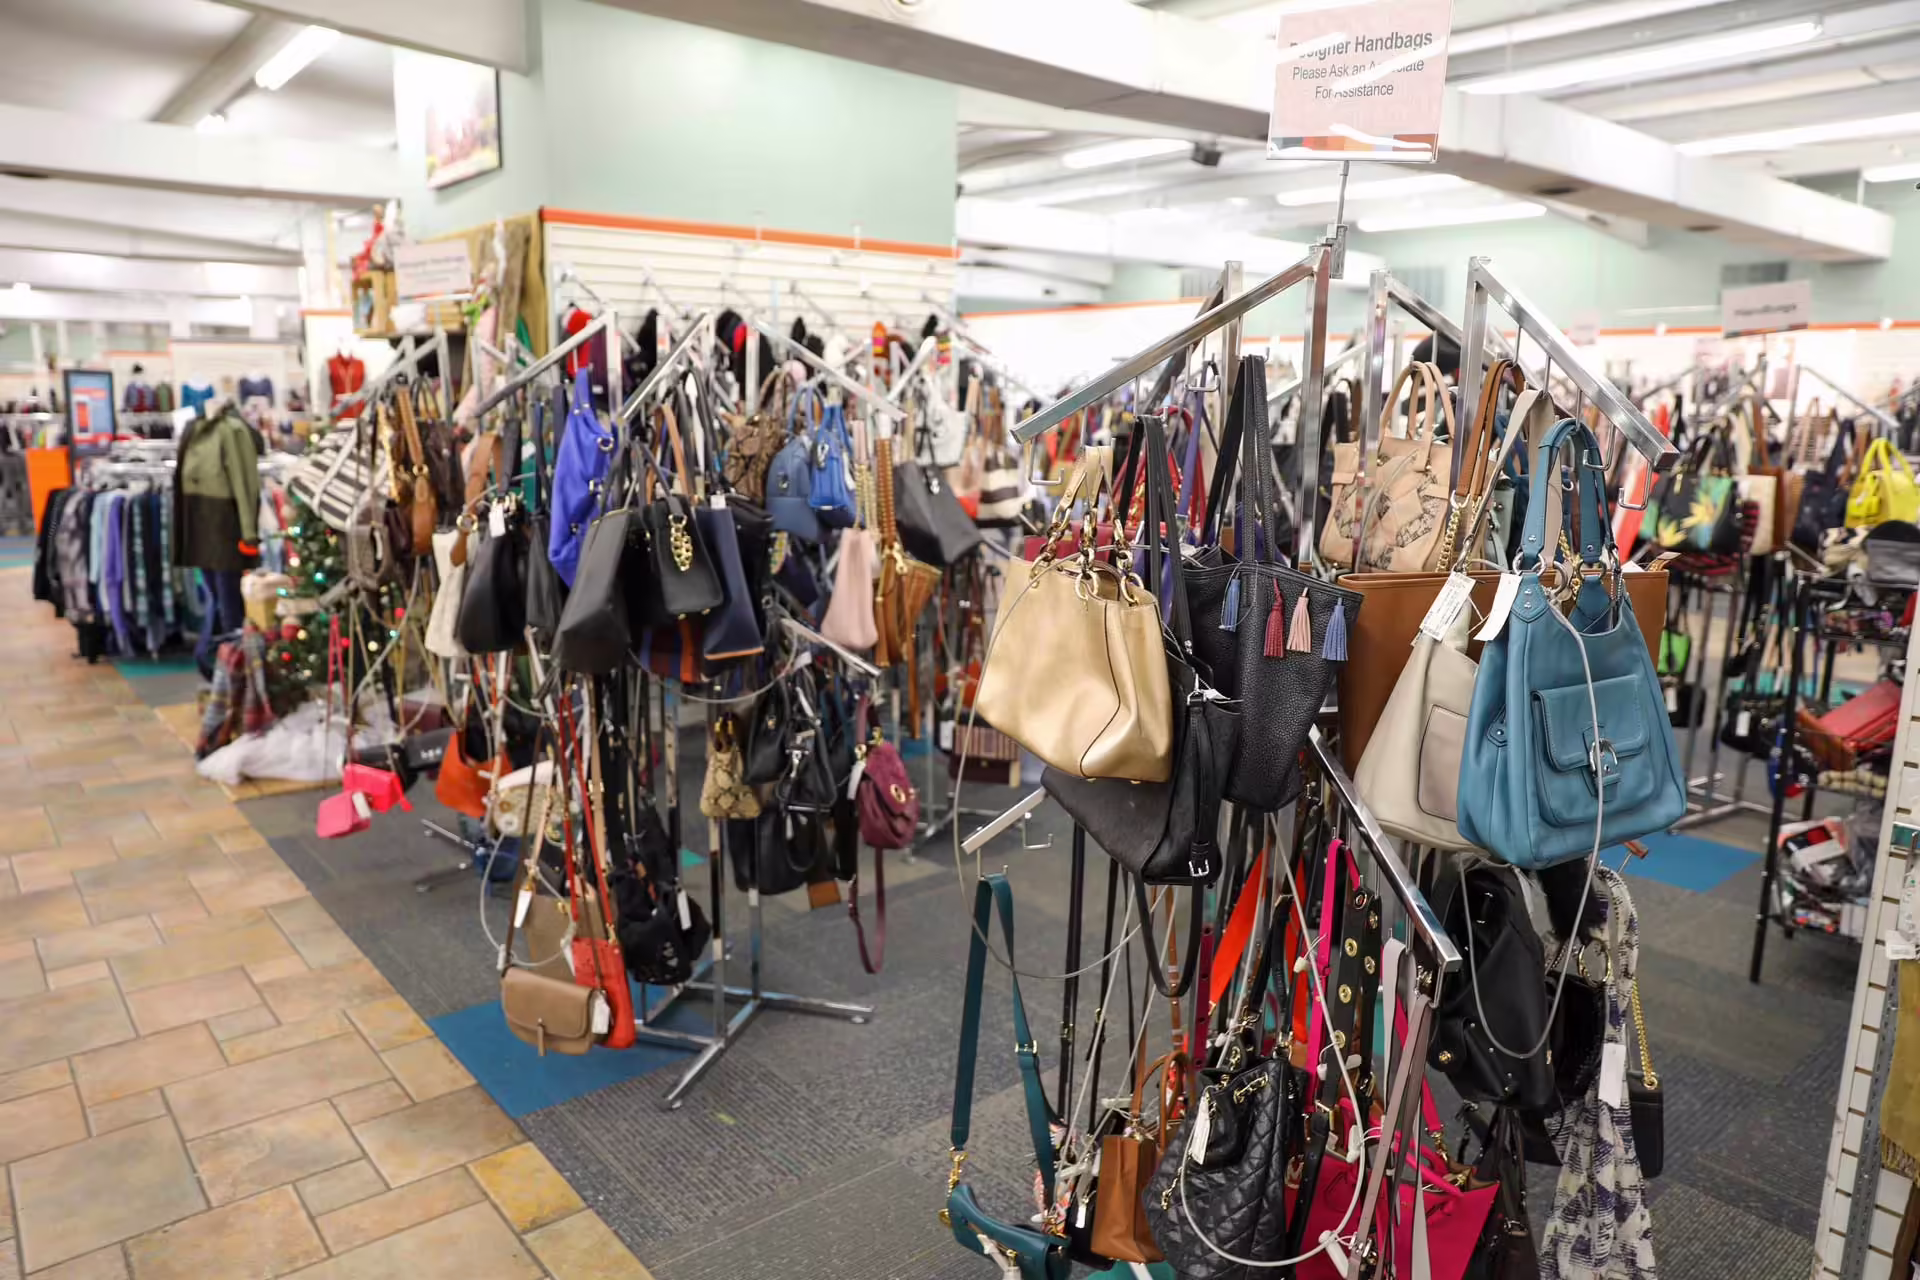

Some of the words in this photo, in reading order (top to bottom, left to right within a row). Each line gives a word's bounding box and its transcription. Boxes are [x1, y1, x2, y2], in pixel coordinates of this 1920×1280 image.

[1354, 31, 1433, 53] Handbags
[1292, 63, 1328, 81] Please
[1328, 63, 1350, 78] Ask
[1351, 64, 1366, 76] an
[1314, 85, 1333, 99] For
